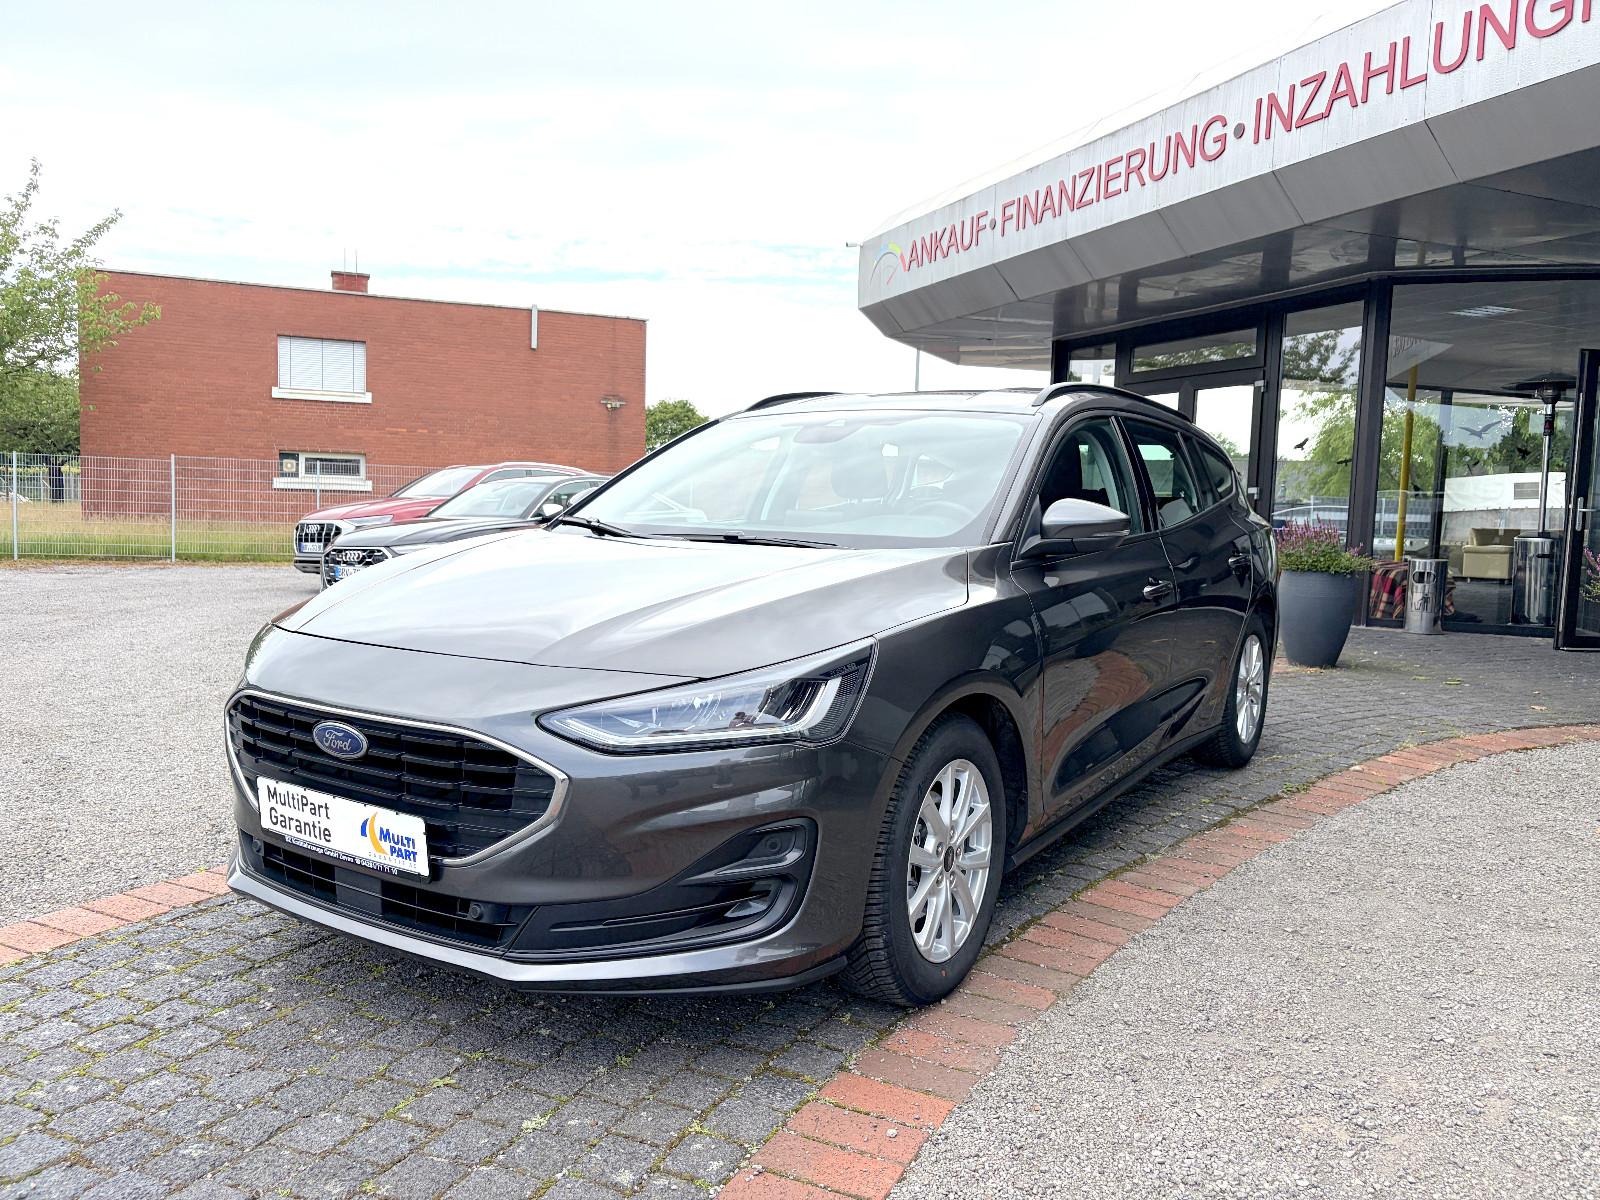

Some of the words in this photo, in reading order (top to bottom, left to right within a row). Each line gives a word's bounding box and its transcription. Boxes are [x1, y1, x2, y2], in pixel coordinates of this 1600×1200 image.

[906, 210, 989, 273] ANKAUF
[1000, 114, 1228, 238] FINANZIERUNG
[1253, 0, 1591, 146] INZAHLUNG
[323, 729, 352, 751] Ford
[266, 784, 330, 820] MultiPart
[269, 806, 332, 843] Garantie
[379, 826, 416, 848] MULTI
[389, 844, 418, 863] PART
